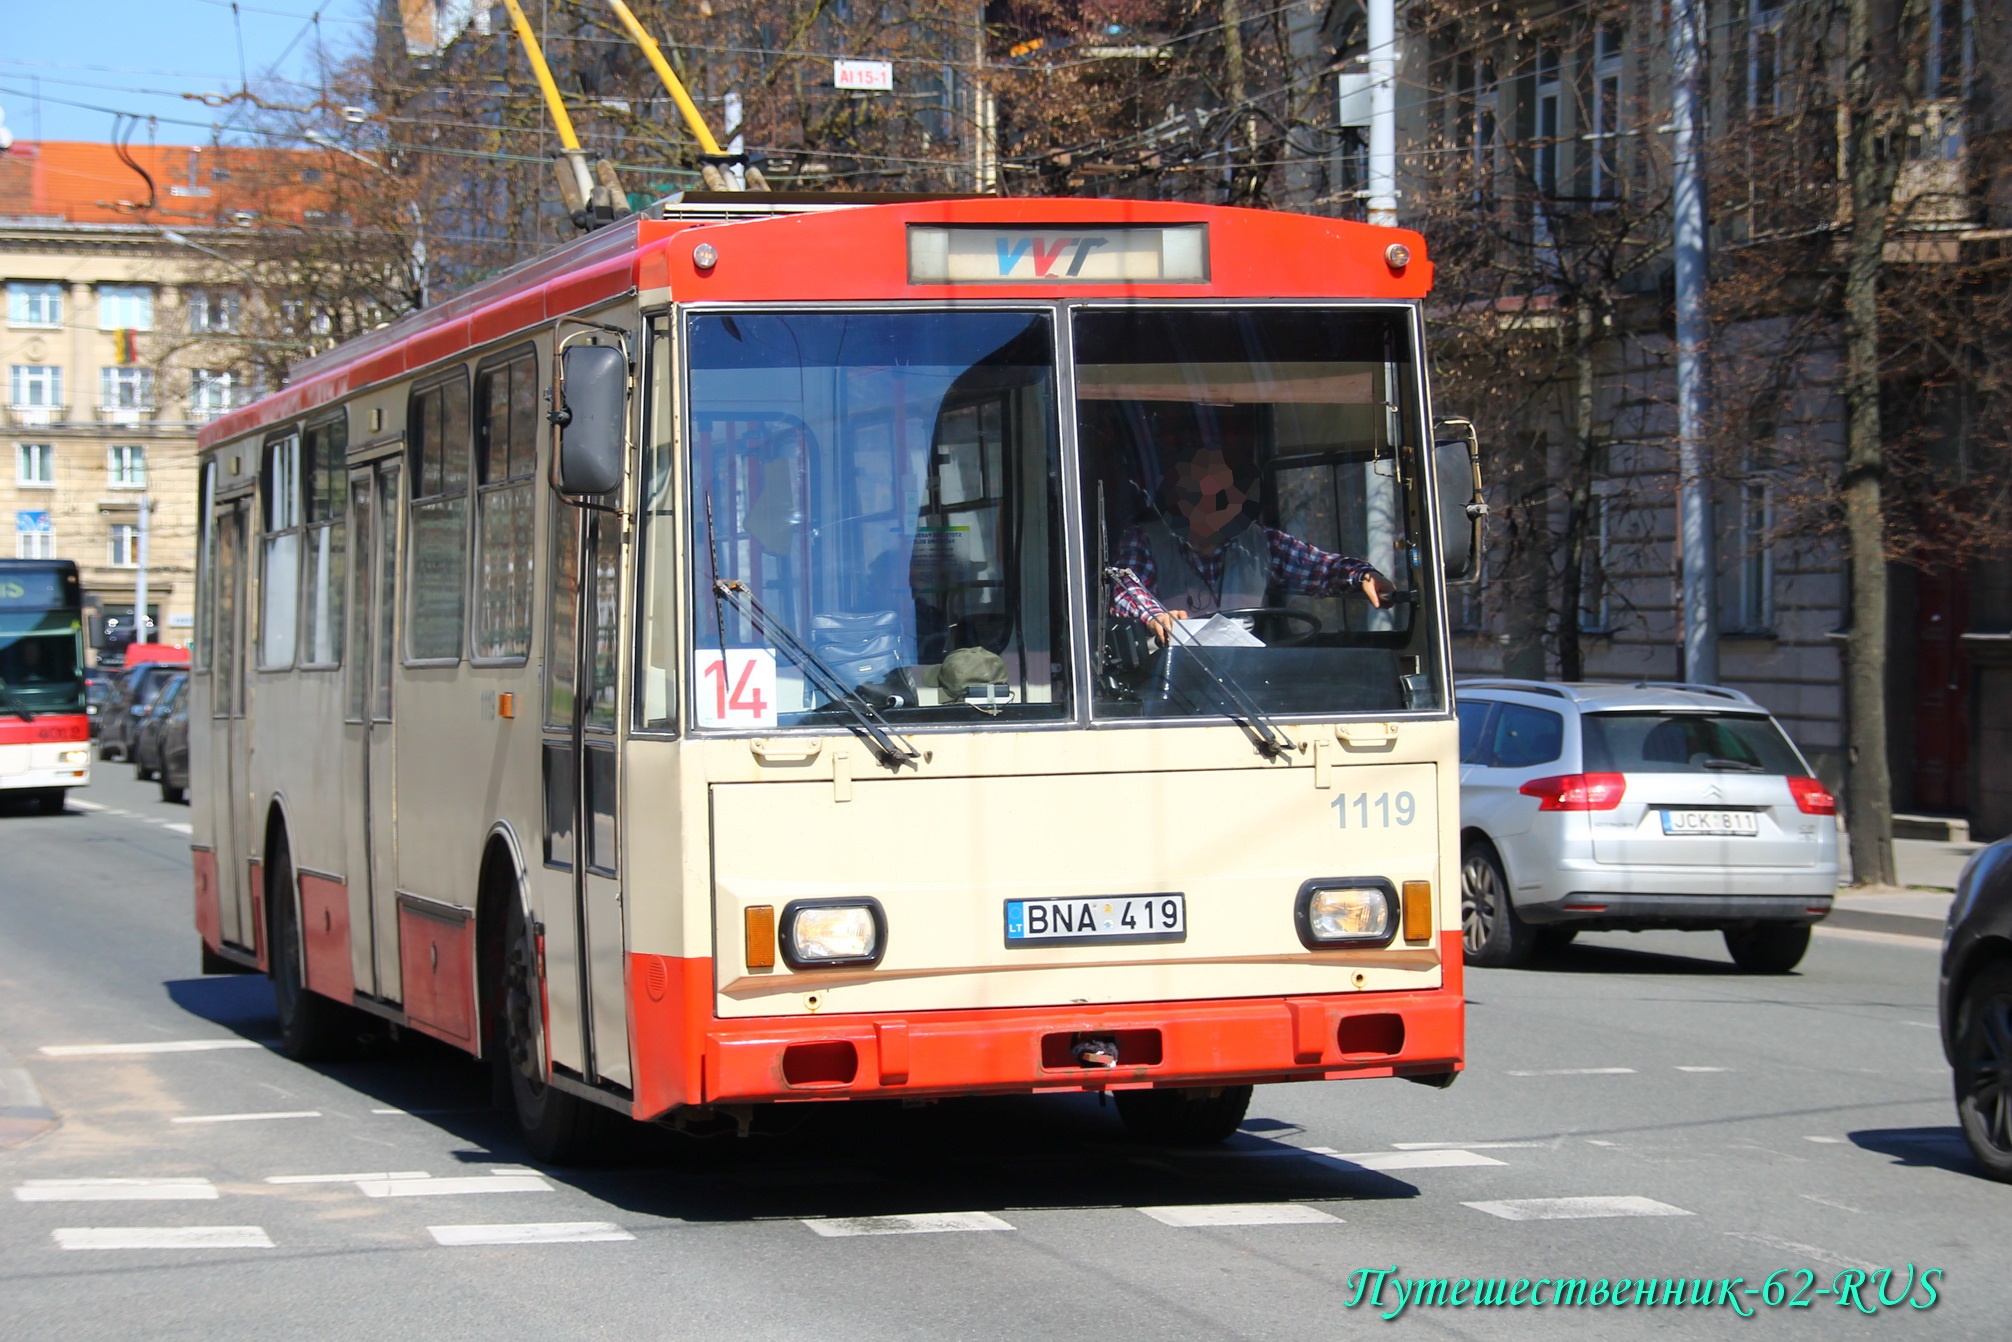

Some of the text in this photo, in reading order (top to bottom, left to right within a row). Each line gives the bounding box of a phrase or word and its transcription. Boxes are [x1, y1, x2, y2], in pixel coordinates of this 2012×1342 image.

[995, 237, 1109, 277] VVT
[703, 659, 767, 719] 14
[1330, 791, 1416, 829] 1119
[1674, 813, 1712, 829] JCK
[1722, 814, 1754, 829] 811
[1028, 900, 1178, 934] BNA 419
